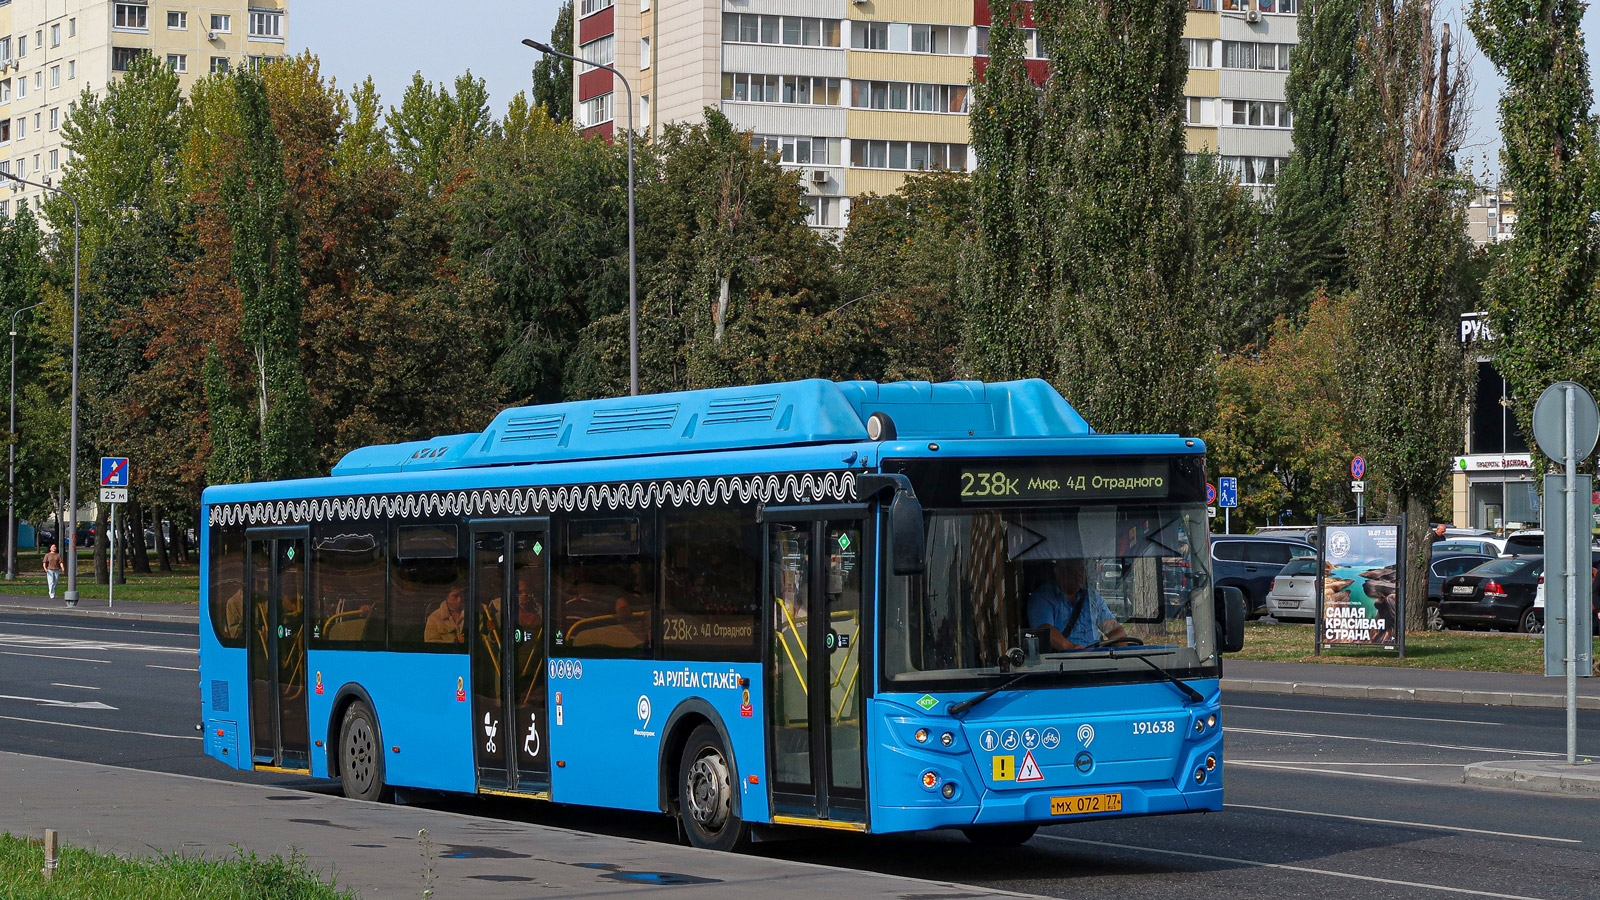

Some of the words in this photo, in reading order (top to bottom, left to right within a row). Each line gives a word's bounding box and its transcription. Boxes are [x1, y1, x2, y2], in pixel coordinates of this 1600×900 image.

[1027, 477, 1061, 491] Мкр.
[1066, 476, 1086, 490] 4Д
[1091, 475, 1164, 490] Отрадного
[105, 491, 116, 500] 25
[1326, 606, 1366, 618] САМАЯ
[713, 623, 752, 638] Отрадного
[1325, 618, 1386, 630] КРАСИВАЯ
[1325, 628, 1371, 640] СТРАНА
[652, 670, 665, 687] ЗА
[666, 667, 700, 688] РУЛЁМ
[701, 668, 742, 689] СТАЖЁР
[1132, 720, 1175, 734] 191638
[1056, 801, 1072, 812] МХ
[1077, 797, 1099, 811] 072
[1106, 794, 1118, 805] 77
